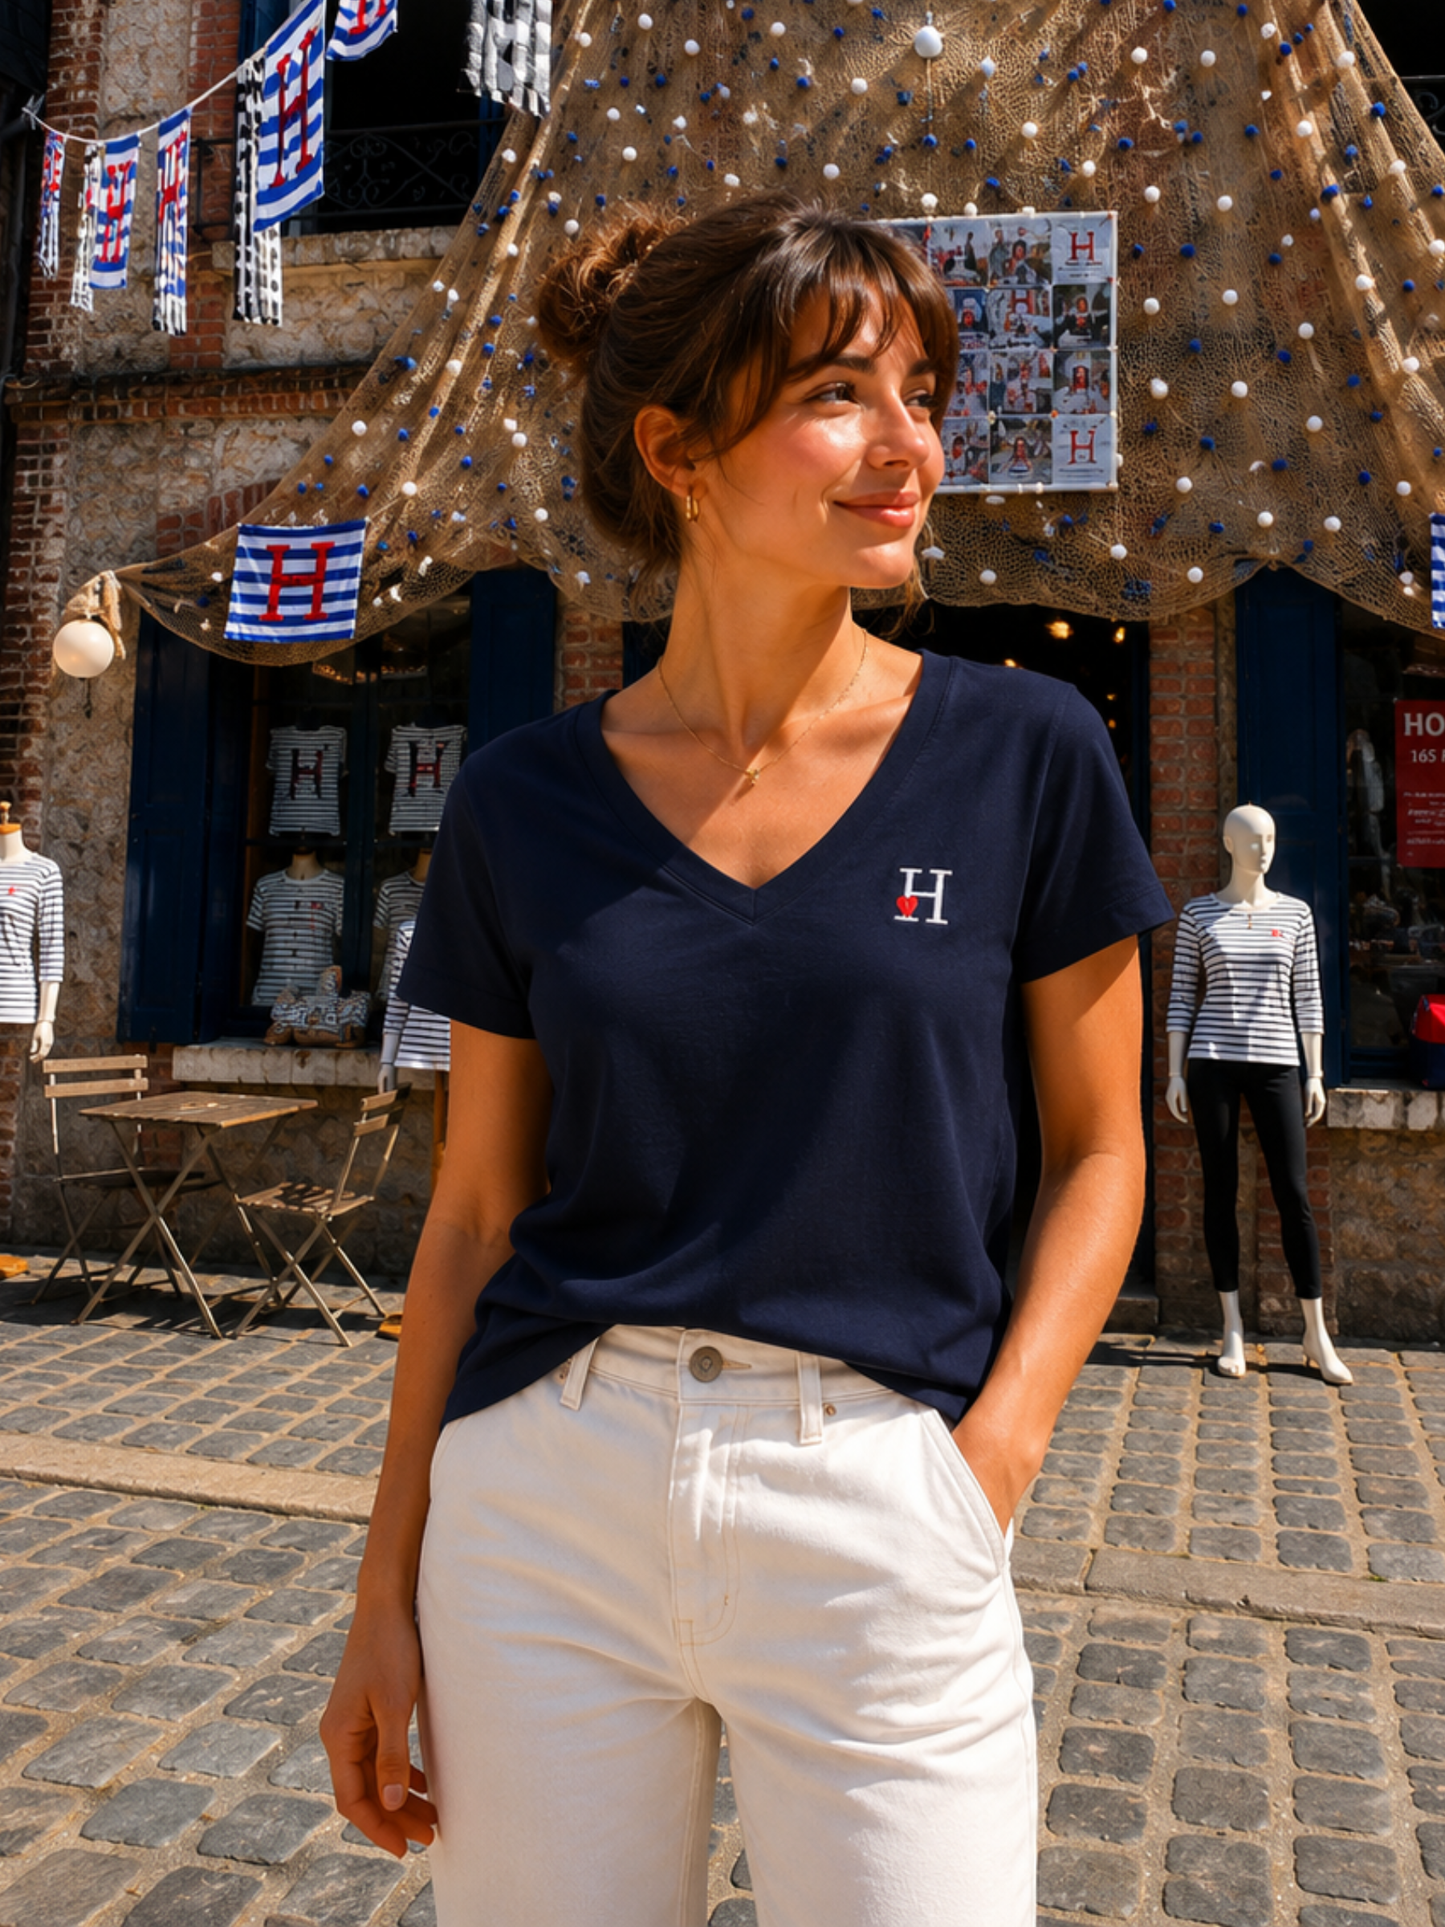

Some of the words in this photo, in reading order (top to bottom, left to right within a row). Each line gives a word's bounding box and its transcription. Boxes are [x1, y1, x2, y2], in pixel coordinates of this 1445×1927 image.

[269, 26, 317, 188] H
[100, 161, 133, 263] H
[1069, 231, 1095, 261] H
[1067, 429, 1097, 465] H
[258, 541, 335, 621] H
[1403, 712, 1445, 737] HO
[290, 749, 324, 800] H
[406, 740, 450, 797] H
[894, 867, 953, 925] H
